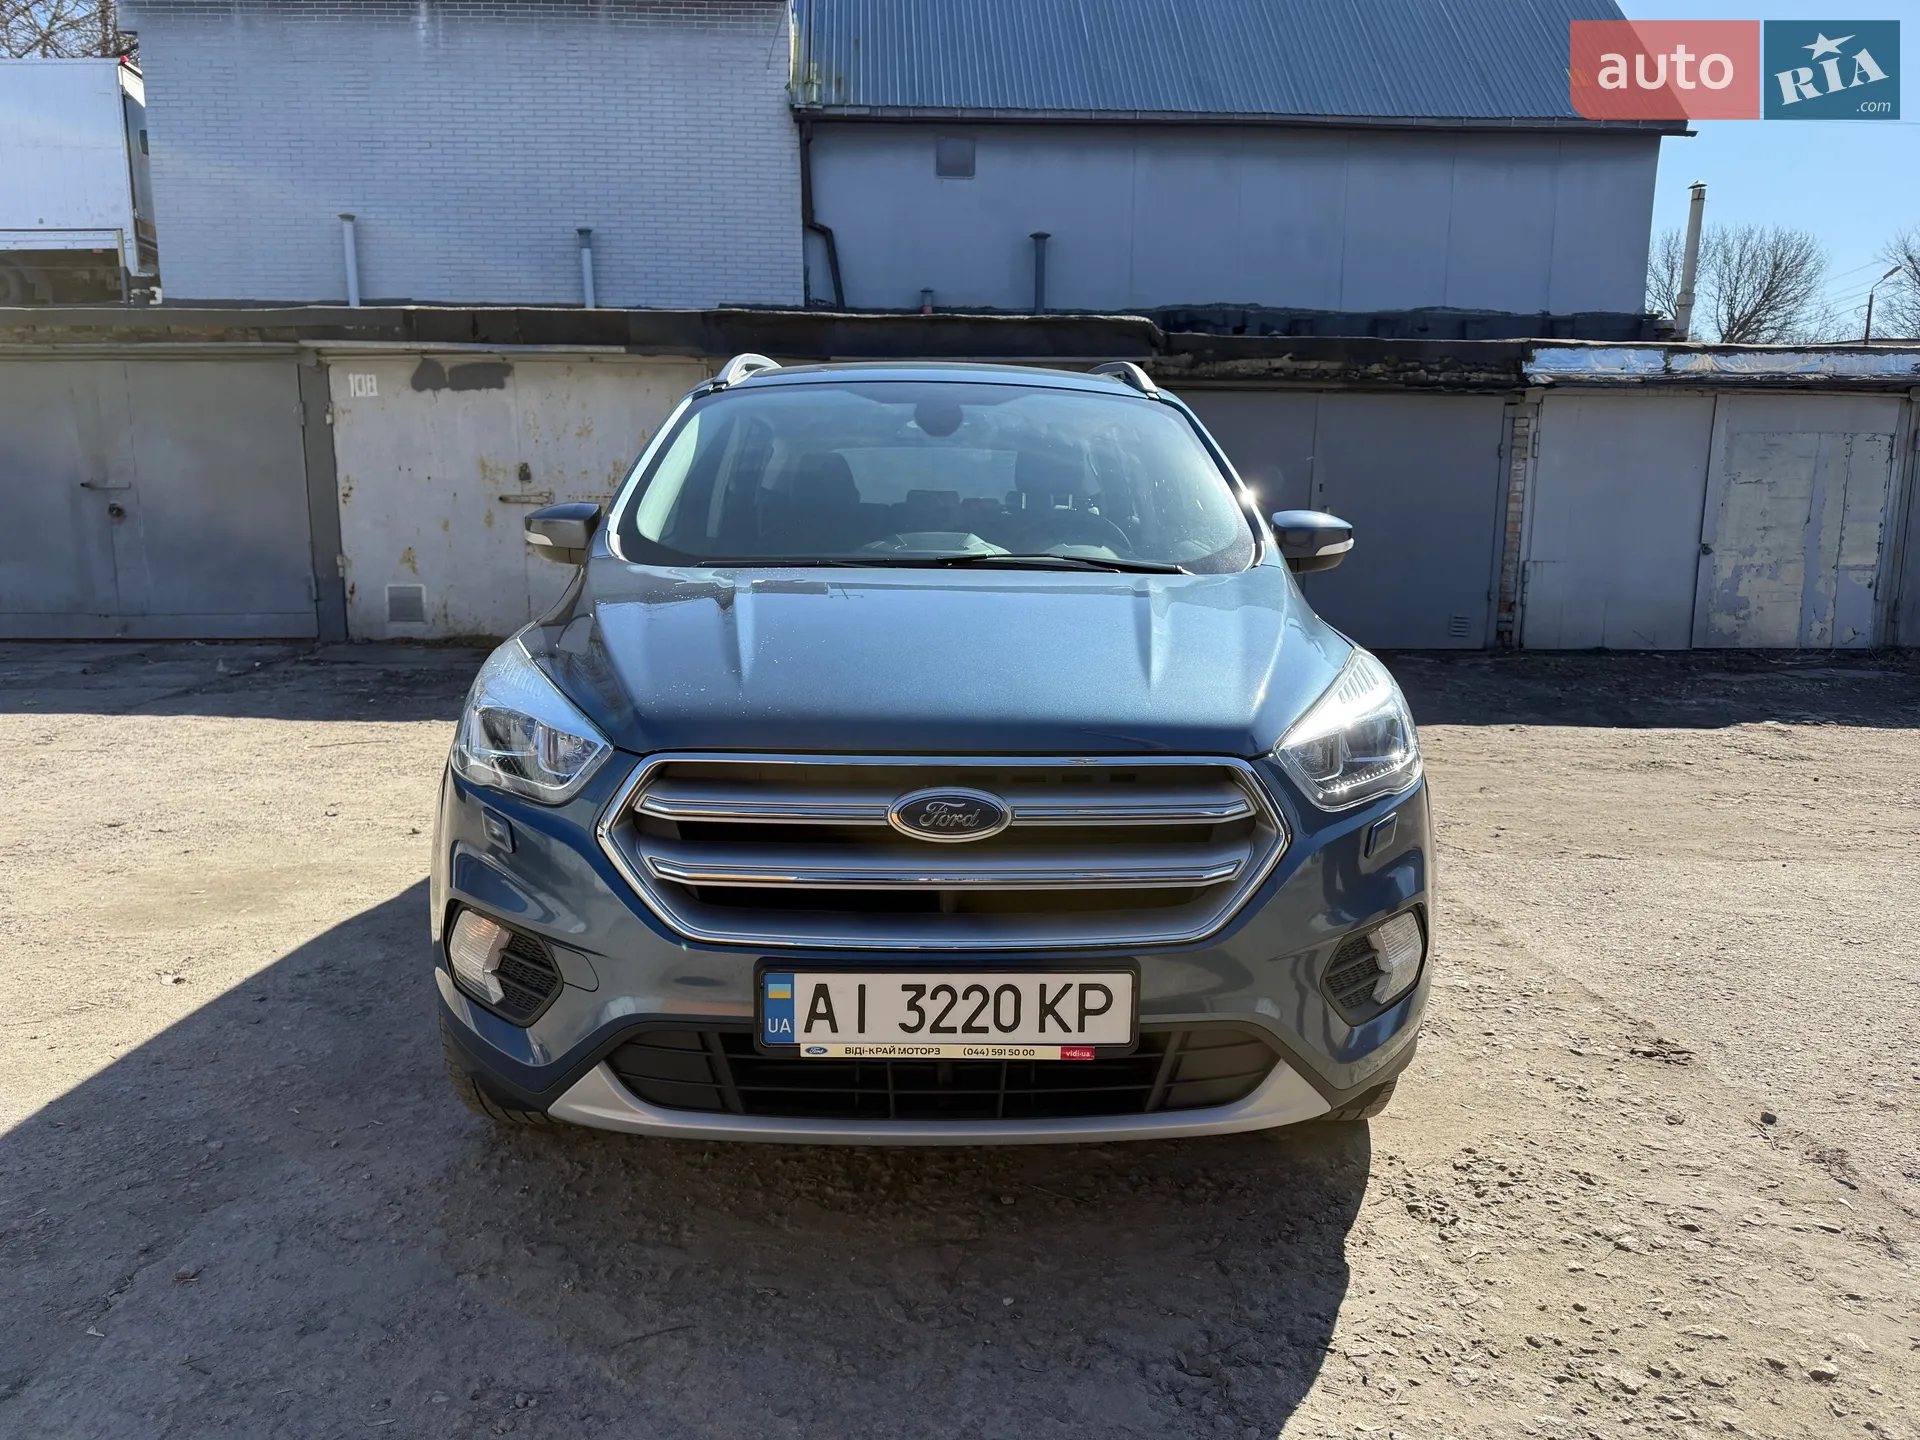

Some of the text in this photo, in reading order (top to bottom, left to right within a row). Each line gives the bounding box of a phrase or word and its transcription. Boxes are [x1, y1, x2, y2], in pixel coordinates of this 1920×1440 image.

[348, 373, 379, 398] 108
[918, 801, 981, 827] Ford
[803, 983, 1114, 1034] AI 3220 KP
[767, 1018, 791, 1034] UA
[897, 1047, 941, 1056] МОТОРЗ
[962, 1047, 1035, 1057] (044) 591 50 00
